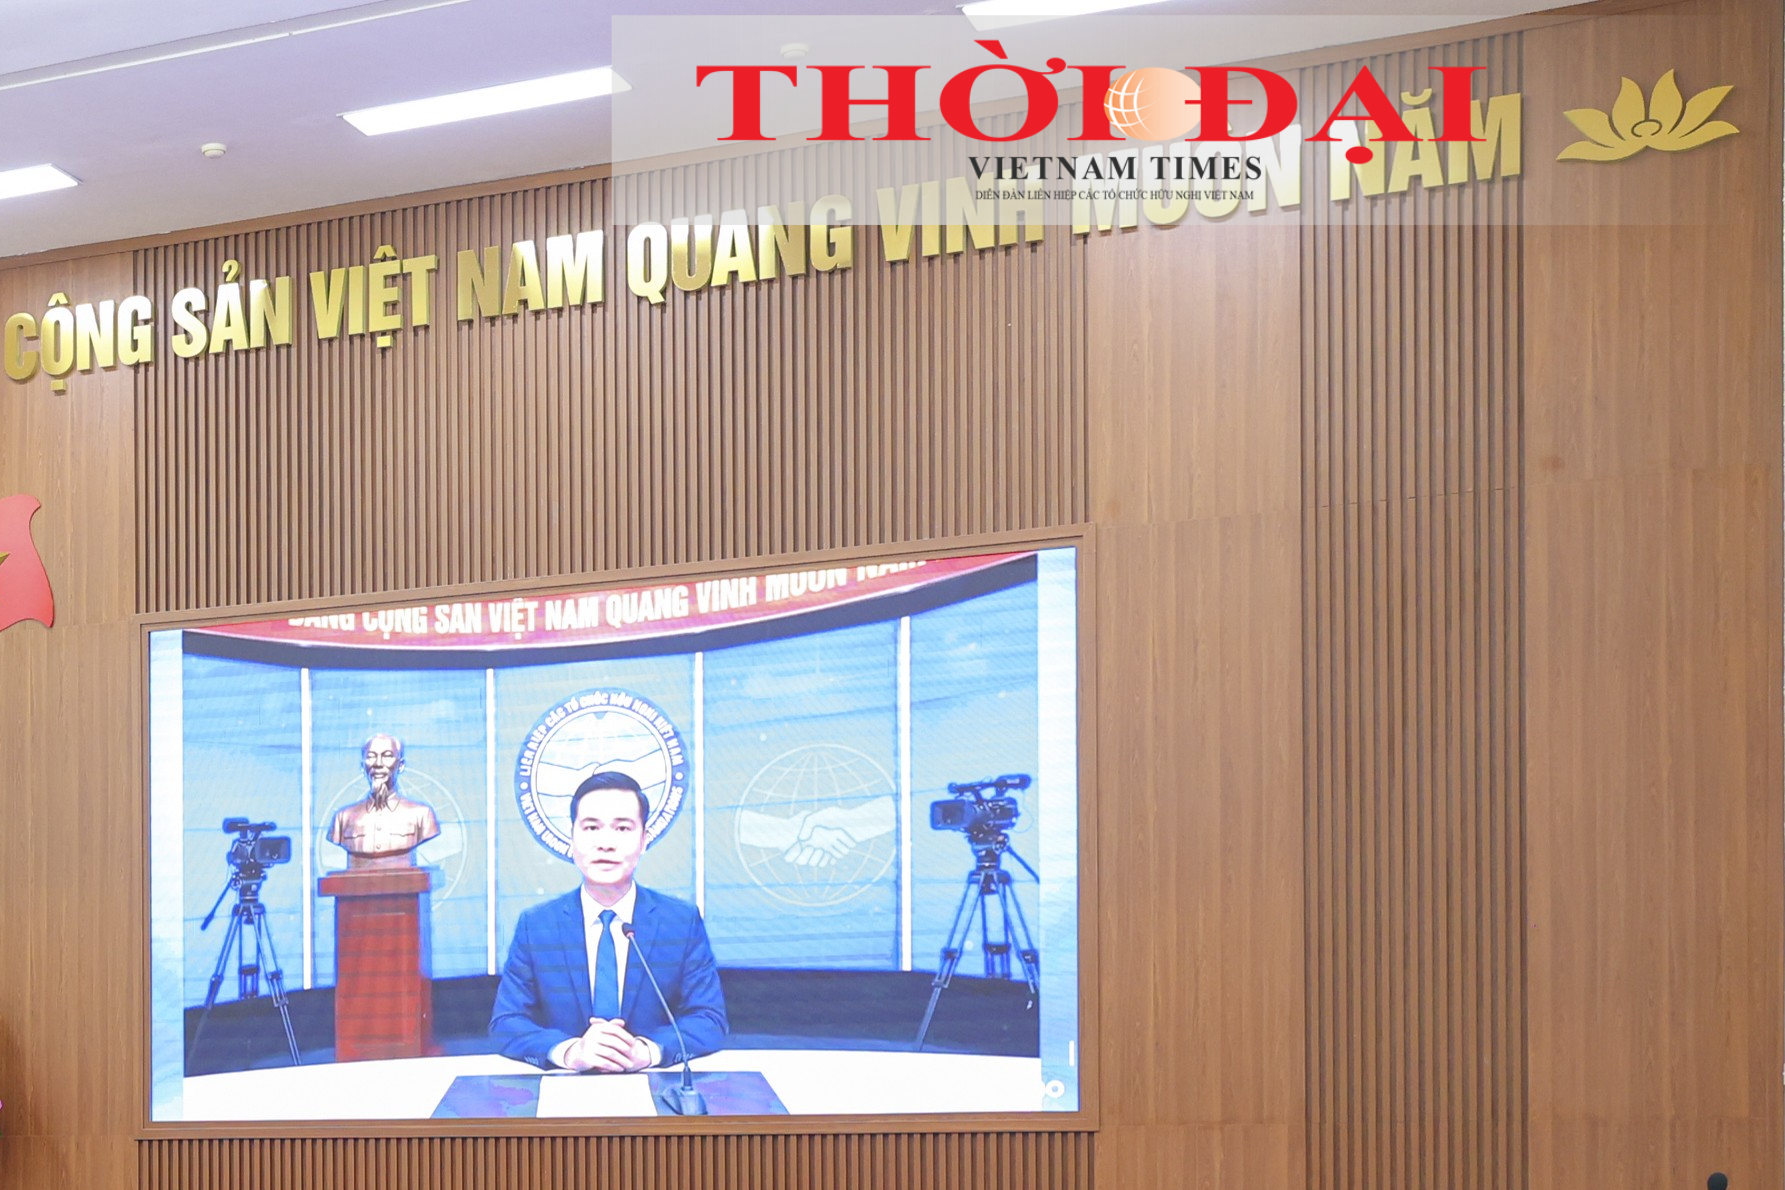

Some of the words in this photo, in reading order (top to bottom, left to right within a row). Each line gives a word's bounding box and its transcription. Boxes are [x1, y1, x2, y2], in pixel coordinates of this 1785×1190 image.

[4, 292, 154, 395] CỘNG
[171, 259, 293, 358] SẢN
[310, 244, 438, 348] VIỆT
[457, 229, 604, 321] NAM
[627, 194, 853, 305] QUANG
[876, 164, 1045, 263] VINH
[488, 597, 538, 640] VIỆT
[544, 595, 599, 631] NAM
[605, 585, 689, 629] QUANG
[695, 575, 757, 615] VINH
